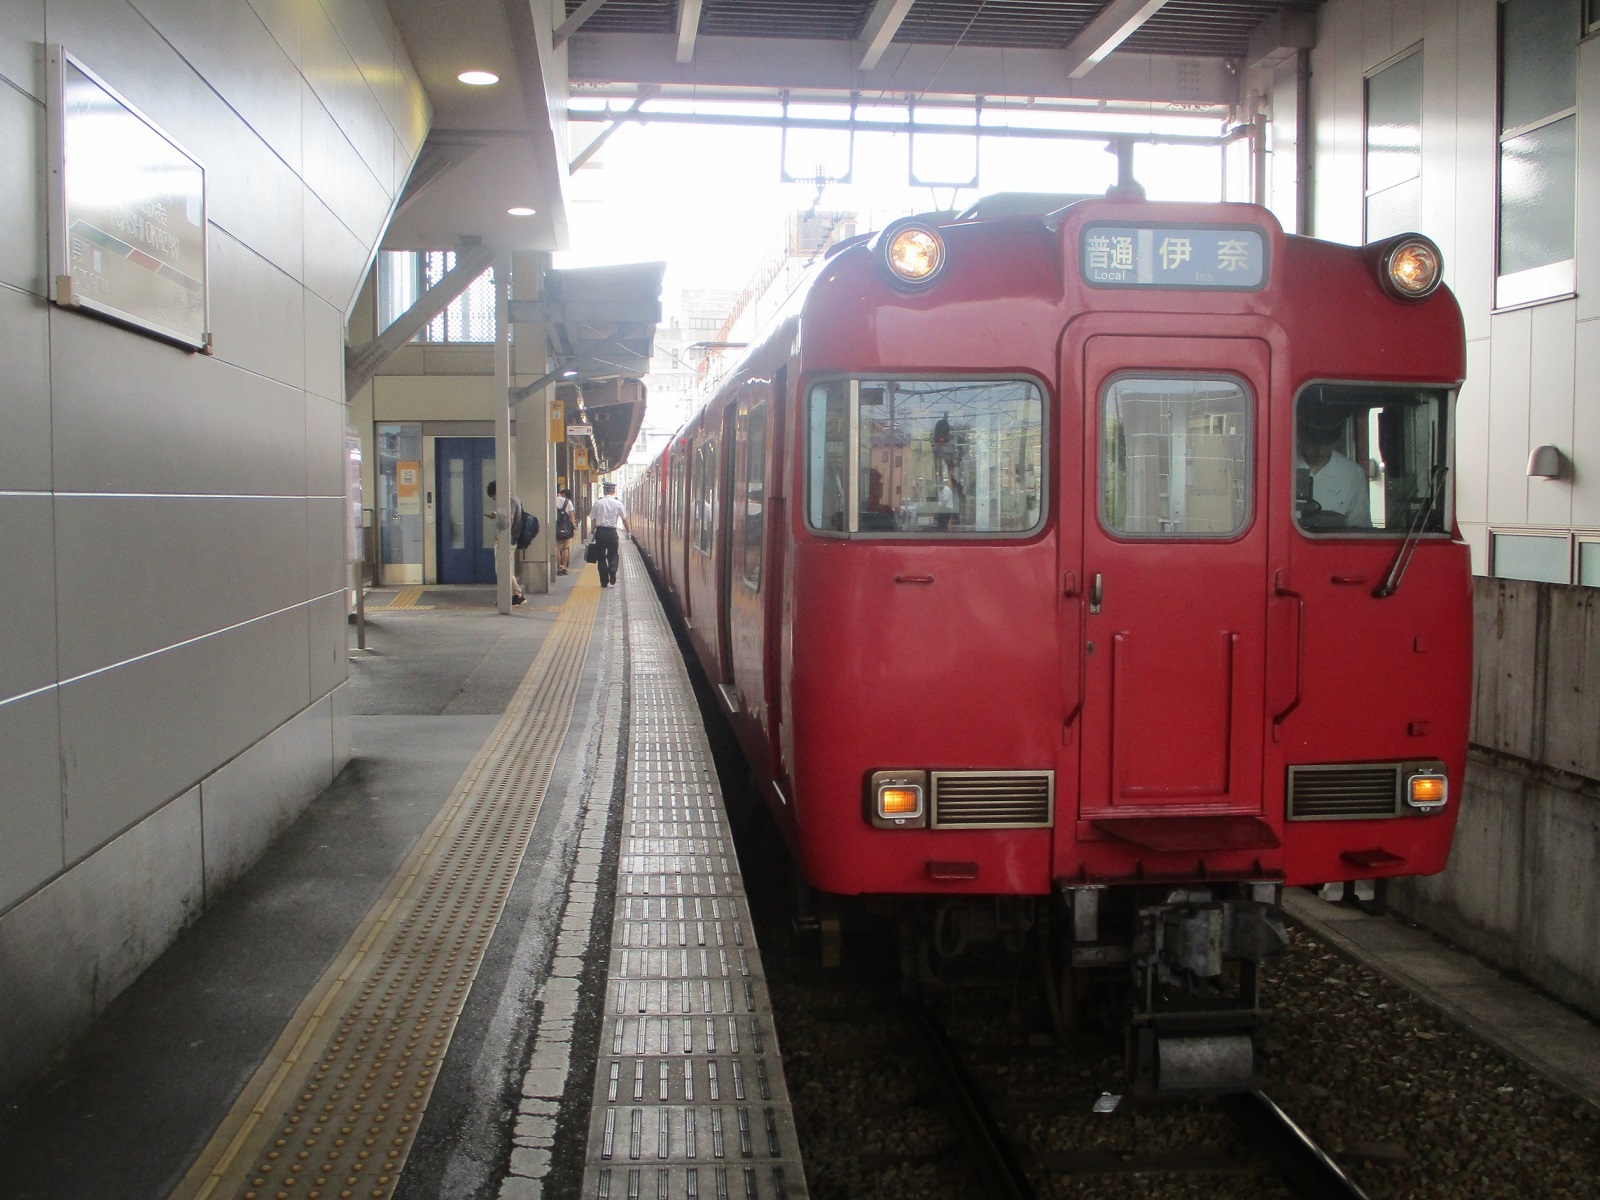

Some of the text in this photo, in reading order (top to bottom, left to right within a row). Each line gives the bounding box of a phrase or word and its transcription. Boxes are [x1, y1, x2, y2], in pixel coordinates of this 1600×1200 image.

[1087, 236, 1250, 272] 普通 伊奈
[1095, 271, 1126, 281] Local
